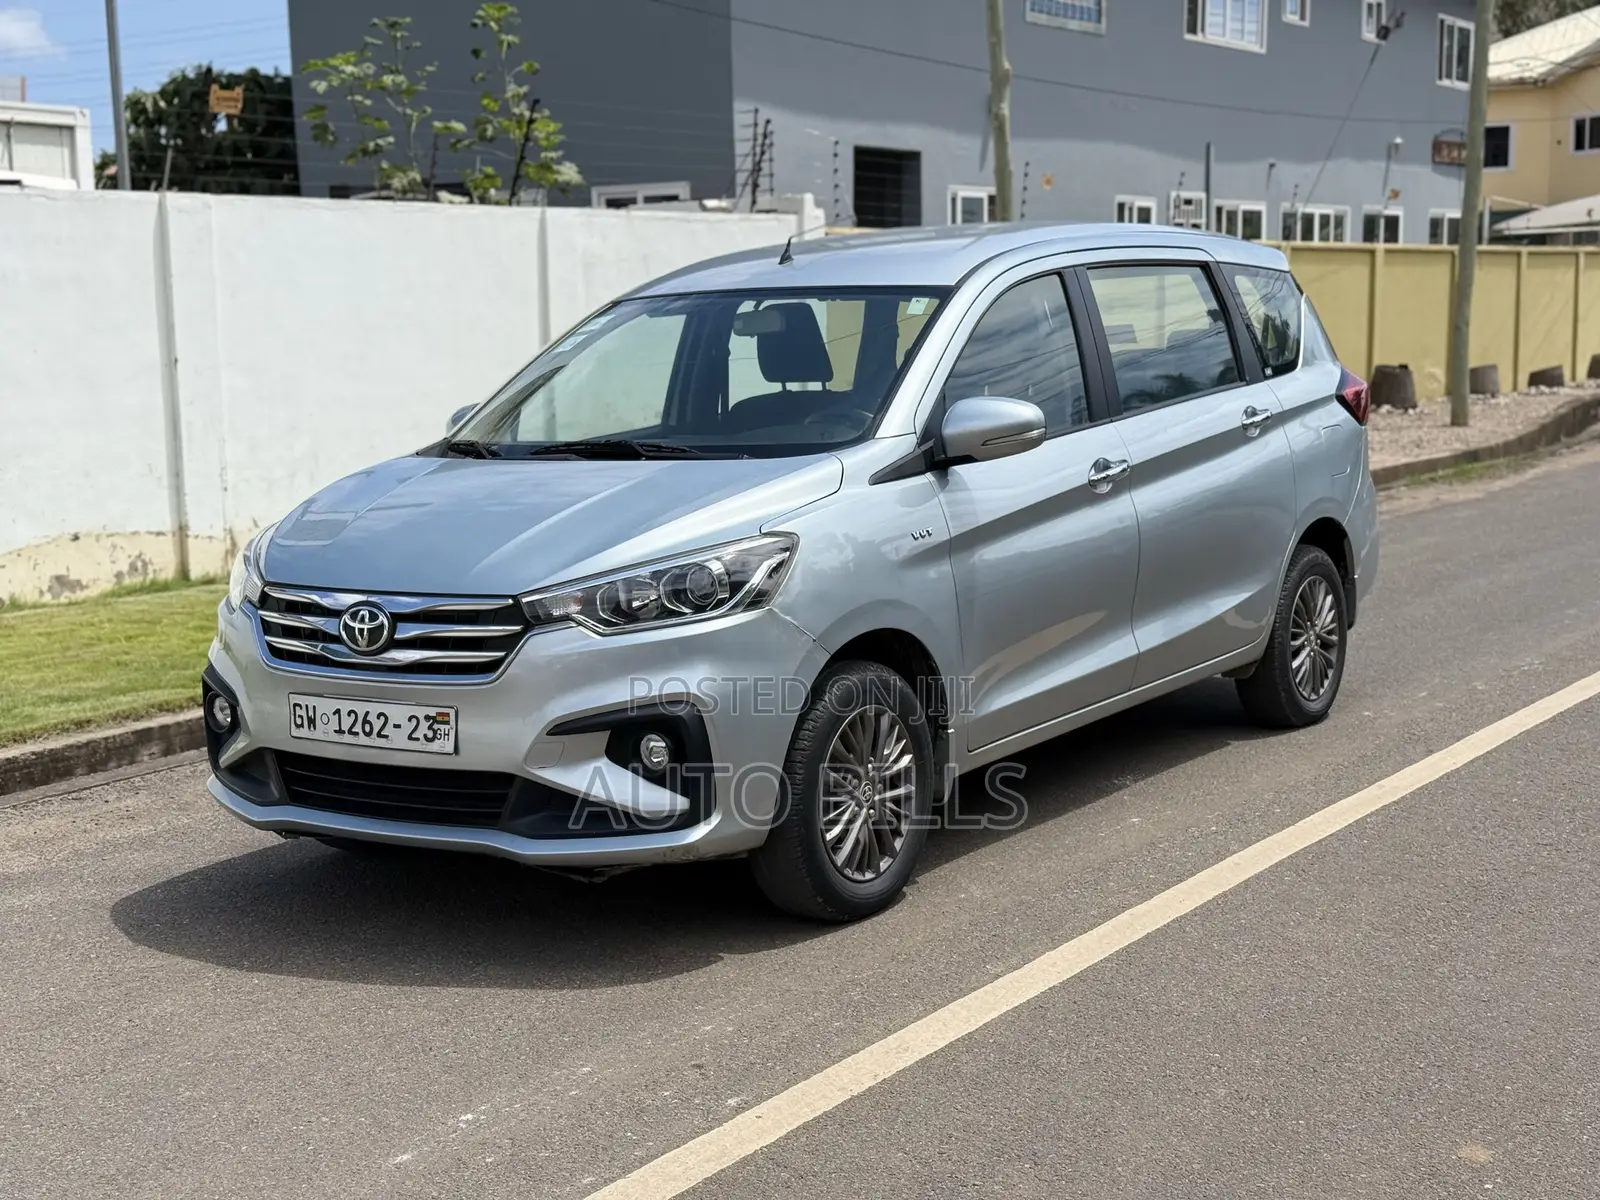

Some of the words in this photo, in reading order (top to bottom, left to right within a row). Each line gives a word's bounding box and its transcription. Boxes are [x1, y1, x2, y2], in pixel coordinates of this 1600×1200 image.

[911, 527, 932, 541] VVT
[292, 702, 317, 731] GW
[332, 707, 438, 743] 1262-23
[436, 727, 450, 742] GH
